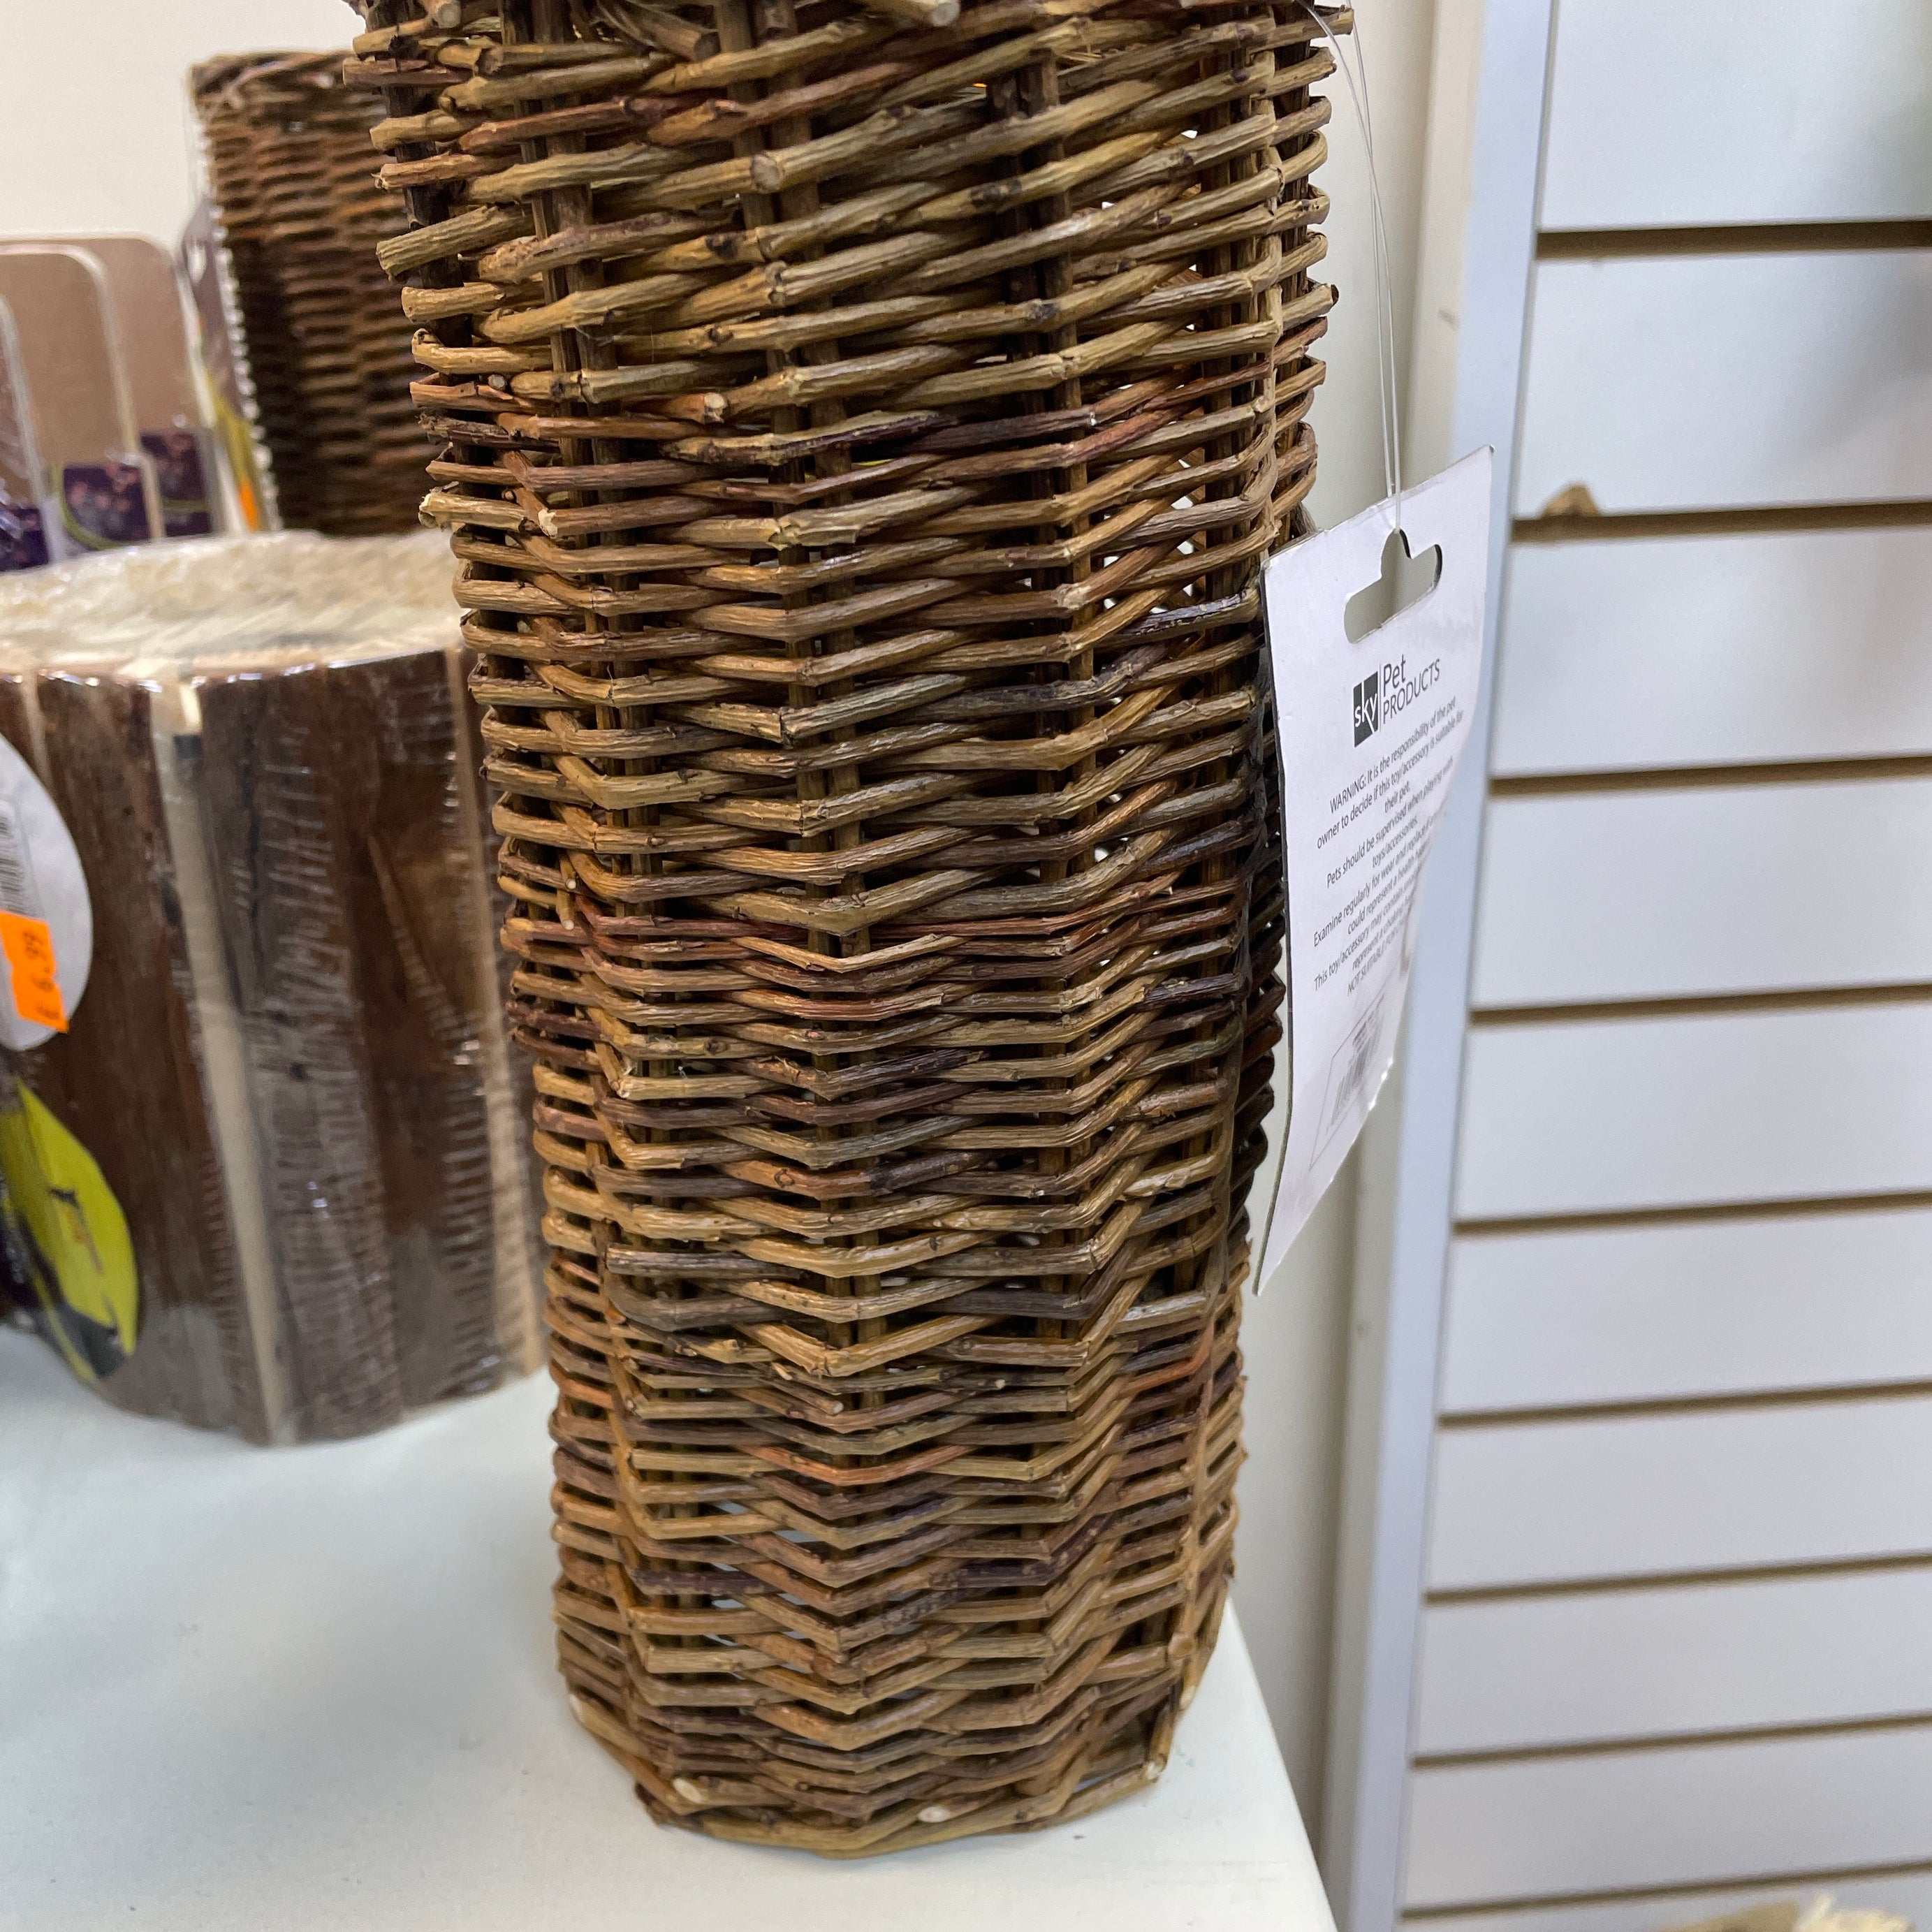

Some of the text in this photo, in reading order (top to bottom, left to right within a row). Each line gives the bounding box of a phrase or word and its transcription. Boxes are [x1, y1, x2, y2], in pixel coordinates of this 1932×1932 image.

[1383, 654, 1405, 697] Pet
[1383, 659, 1440, 724] PRODUCTS
[1317, 822, 1340, 849] owner
[1341, 815, 1348, 829] to
[1350, 793, 1372, 821] decide
[1374, 785, 1377, 801] if
[1380, 777, 1390, 796] this
[1330, 774, 1366, 814] WARNING:
[1368, 770, 1373, 784] It
[1374, 766, 1378, 780] is
[1380, 756, 1390, 773] the
[1385, 791, 1399, 813] their
[1327, 868, 1341, 888] Pets
[1343, 842, 1364, 874] should
[1366, 836, 1375, 852] be
[1376, 802, 1406, 844] supervised
[1314, 912, 1342, 947] Examine
[1343, 883, 1370, 919] regularly
[1372, 873, 1380, 889] for
[1348, 906, 1365, 935] could
[1314, 972, 1327, 991] This
[1329, 924, 1370, 976] toy/accessory
[1347, 971, 1360, 996] NOT
